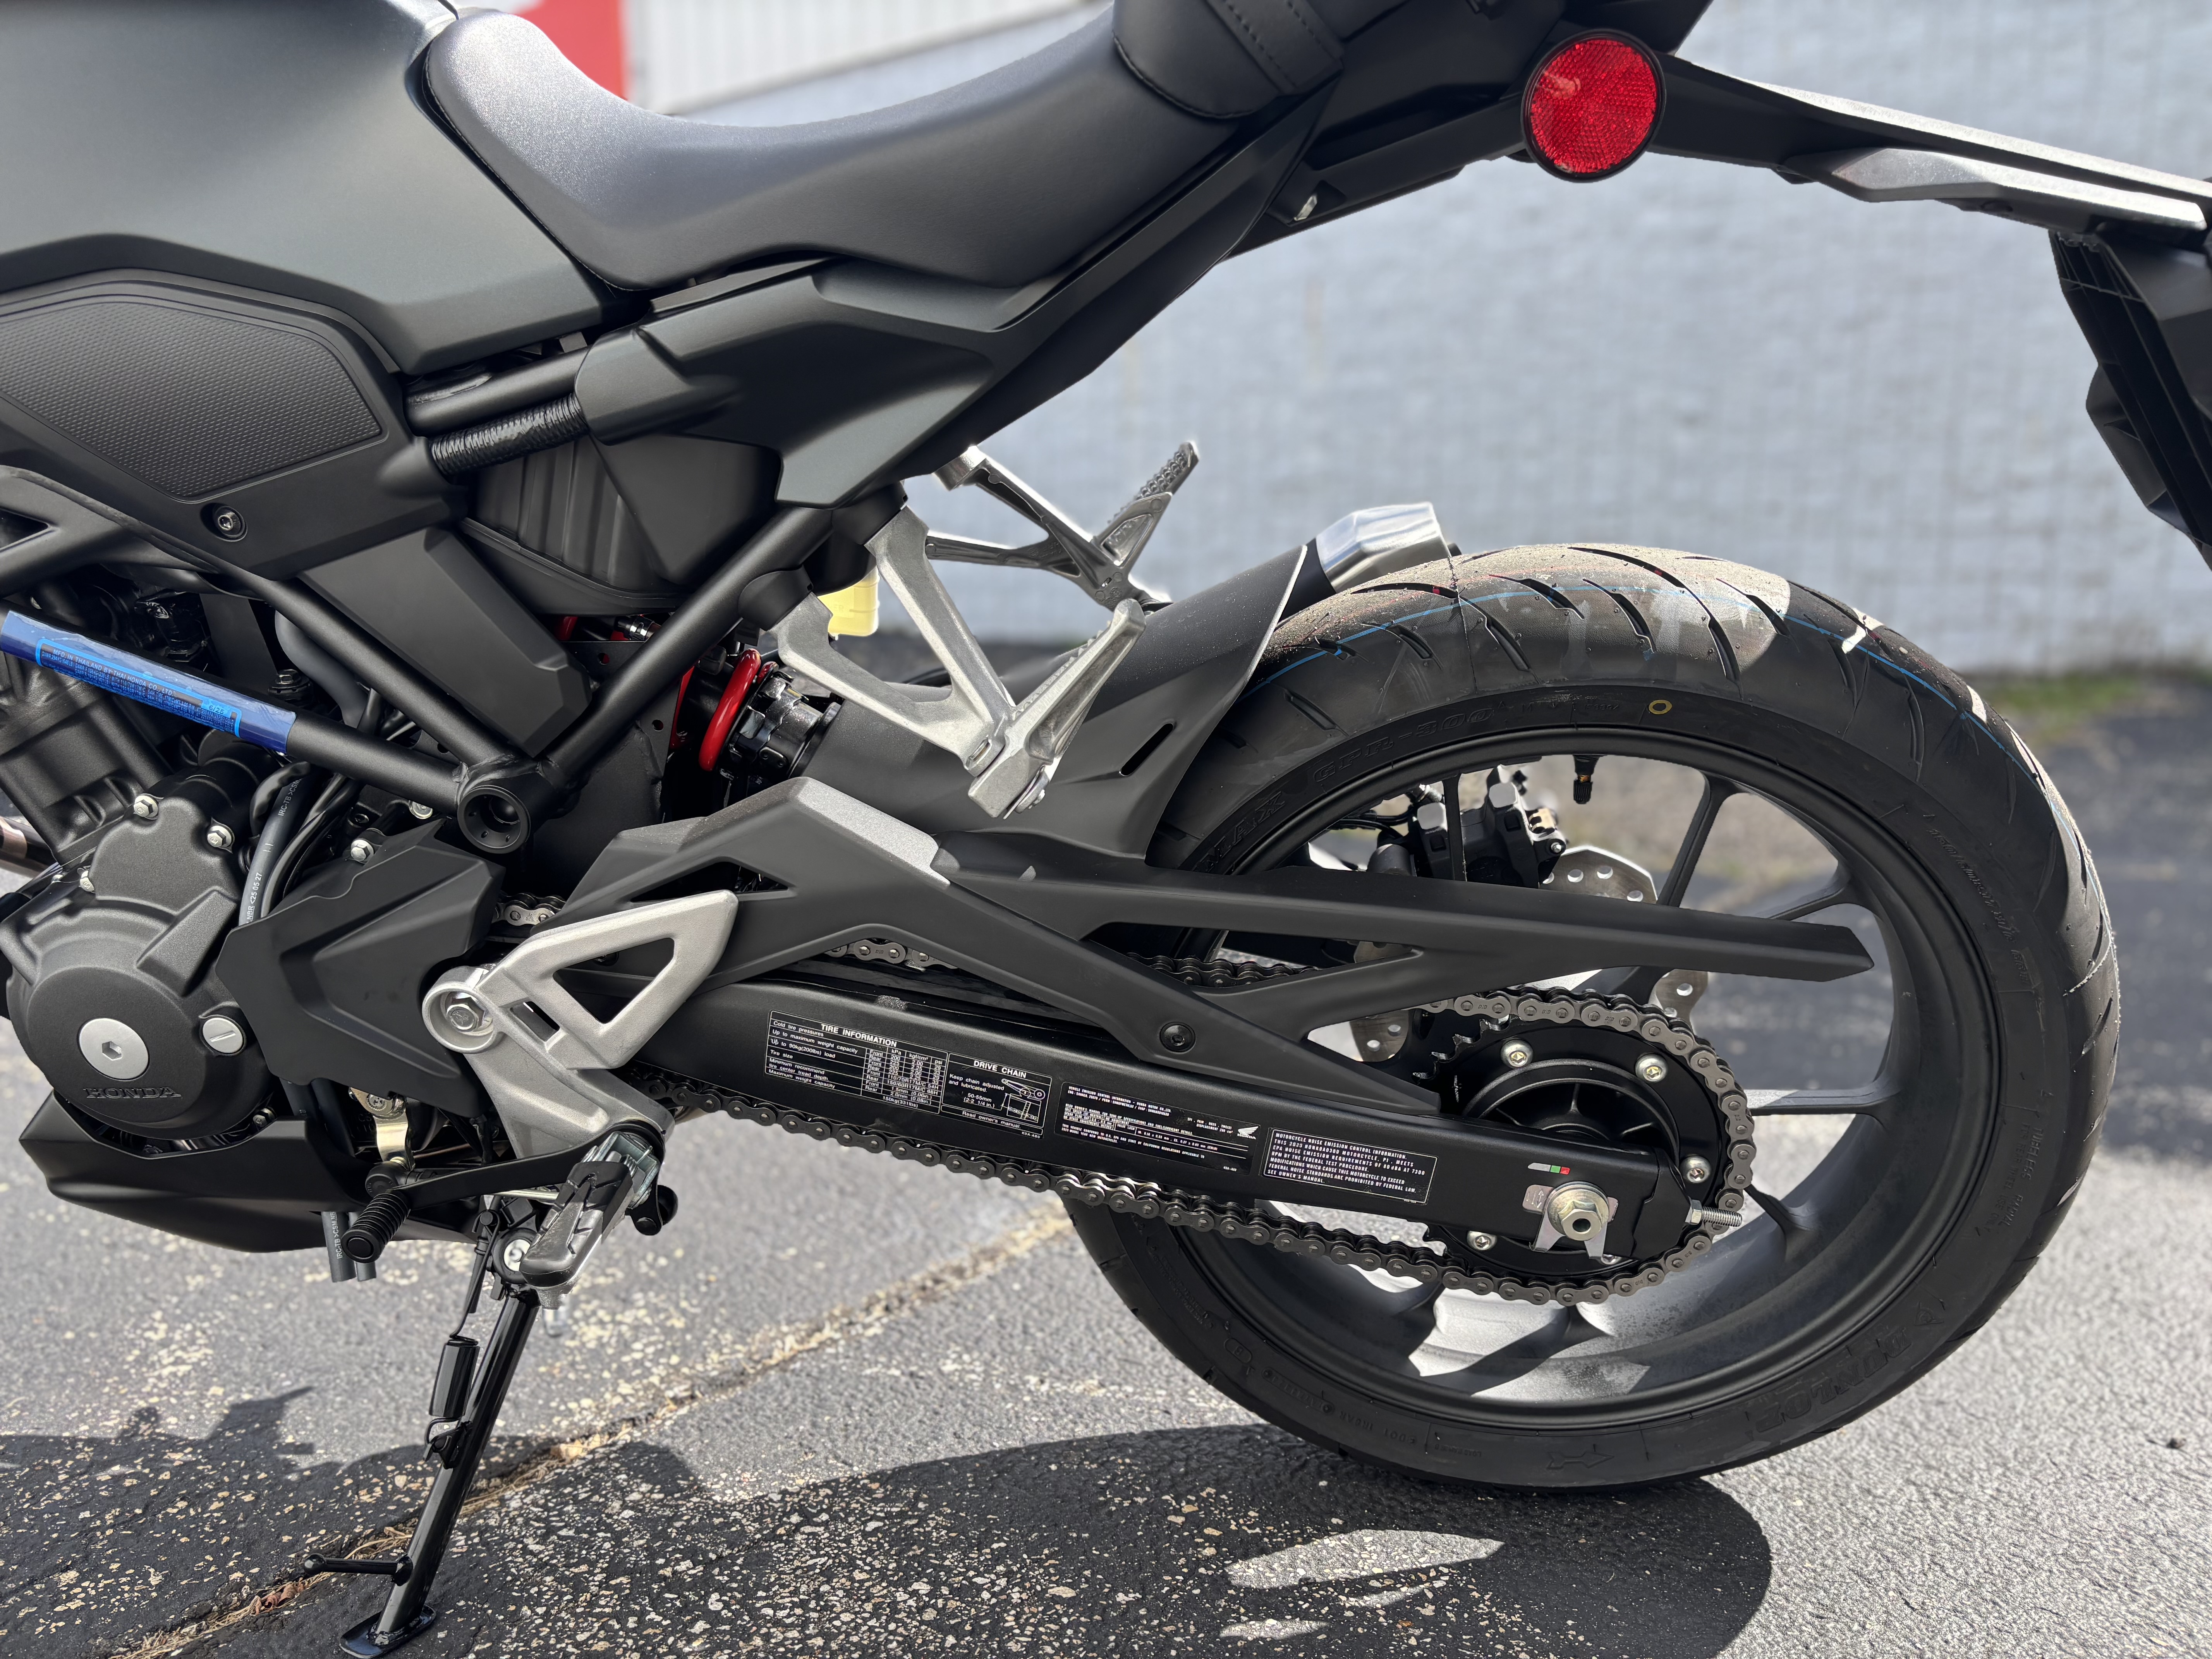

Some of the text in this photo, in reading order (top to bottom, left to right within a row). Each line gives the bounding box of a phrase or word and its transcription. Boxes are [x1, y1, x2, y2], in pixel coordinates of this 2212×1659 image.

[75, 656, 102, 671] THAILAND
[103, 666, 112, 675] BY
[113, 670, 126, 680] THAI
[127, 675, 146, 687] HONDA
[208, 704, 224, 715] 6/25
[1314, 708, 1494, 783] GPR-300
[278, 796, 292, 816] IRC-TB
[1200, 792, 1285, 871] MAX
[252, 881, 260, 890] 05
[255, 872, 263, 881] 27
[798, 1027, 824, 1038] pressures
[820, 1023, 897, 1048] TIRE INFORMATION
[770, 1037, 779, 1046] Up
[788, 1042, 822, 1056] 90kg(200lbs)
[790, 1033, 815, 1044] maximum
[817, 1039, 835, 1049] weight
[836, 1044, 858, 1055] capacity
[769, 1057, 825, 1075] Minimum recommend
[973, 1060, 1027, 1079] DRIVE CHAIN
[768, 1068, 835, 1089] Maximum weight capacity
[949, 1073, 1005, 1092] Keep chain adjusted
[960, 1082, 988, 1093] lubricated.
[83, 1087, 182, 1098] HONDA
[962, 1110, 1022, 1130] Read owner's manual.
[1275, 1132, 1307, 1142] MOTORCYCLE
[1324, 1141, 1348, 1149] EMISSION
[1349, 1145, 1371, 1153] CONTROL
[1372, 1149, 1408, 1159] INFORMATION.
[2012, 1142, 2026, 1164] REAR
[1302, 1156, 1324, 1164] FEDERAL
[1338, 1162, 1370, 1172] PROCEDURE.
[1303, 1150, 1329, 1159] EMISSION
[1331, 1155, 1372, 1166] REQUIREMENTS
[1270, 1157, 1305, 1167] MODIFICATIONS
[1350, 1171, 1379, 1180] MOTORCYCLE
[1278, 1171, 1301, 1179] OWNER'S
[1303, 1175, 1326, 1183] MANUAL.
[1997, 1126, 2044, 1227] TUBELESS RADIAL
[1306, 1169, 1334, 1179] STANDARDS
[1344, 1176, 1374, 1186] PROHIBITED
[1382, 1183, 1403, 1191] FEDERAL
[1753, 1325, 1913, 1435] DUNLOP
